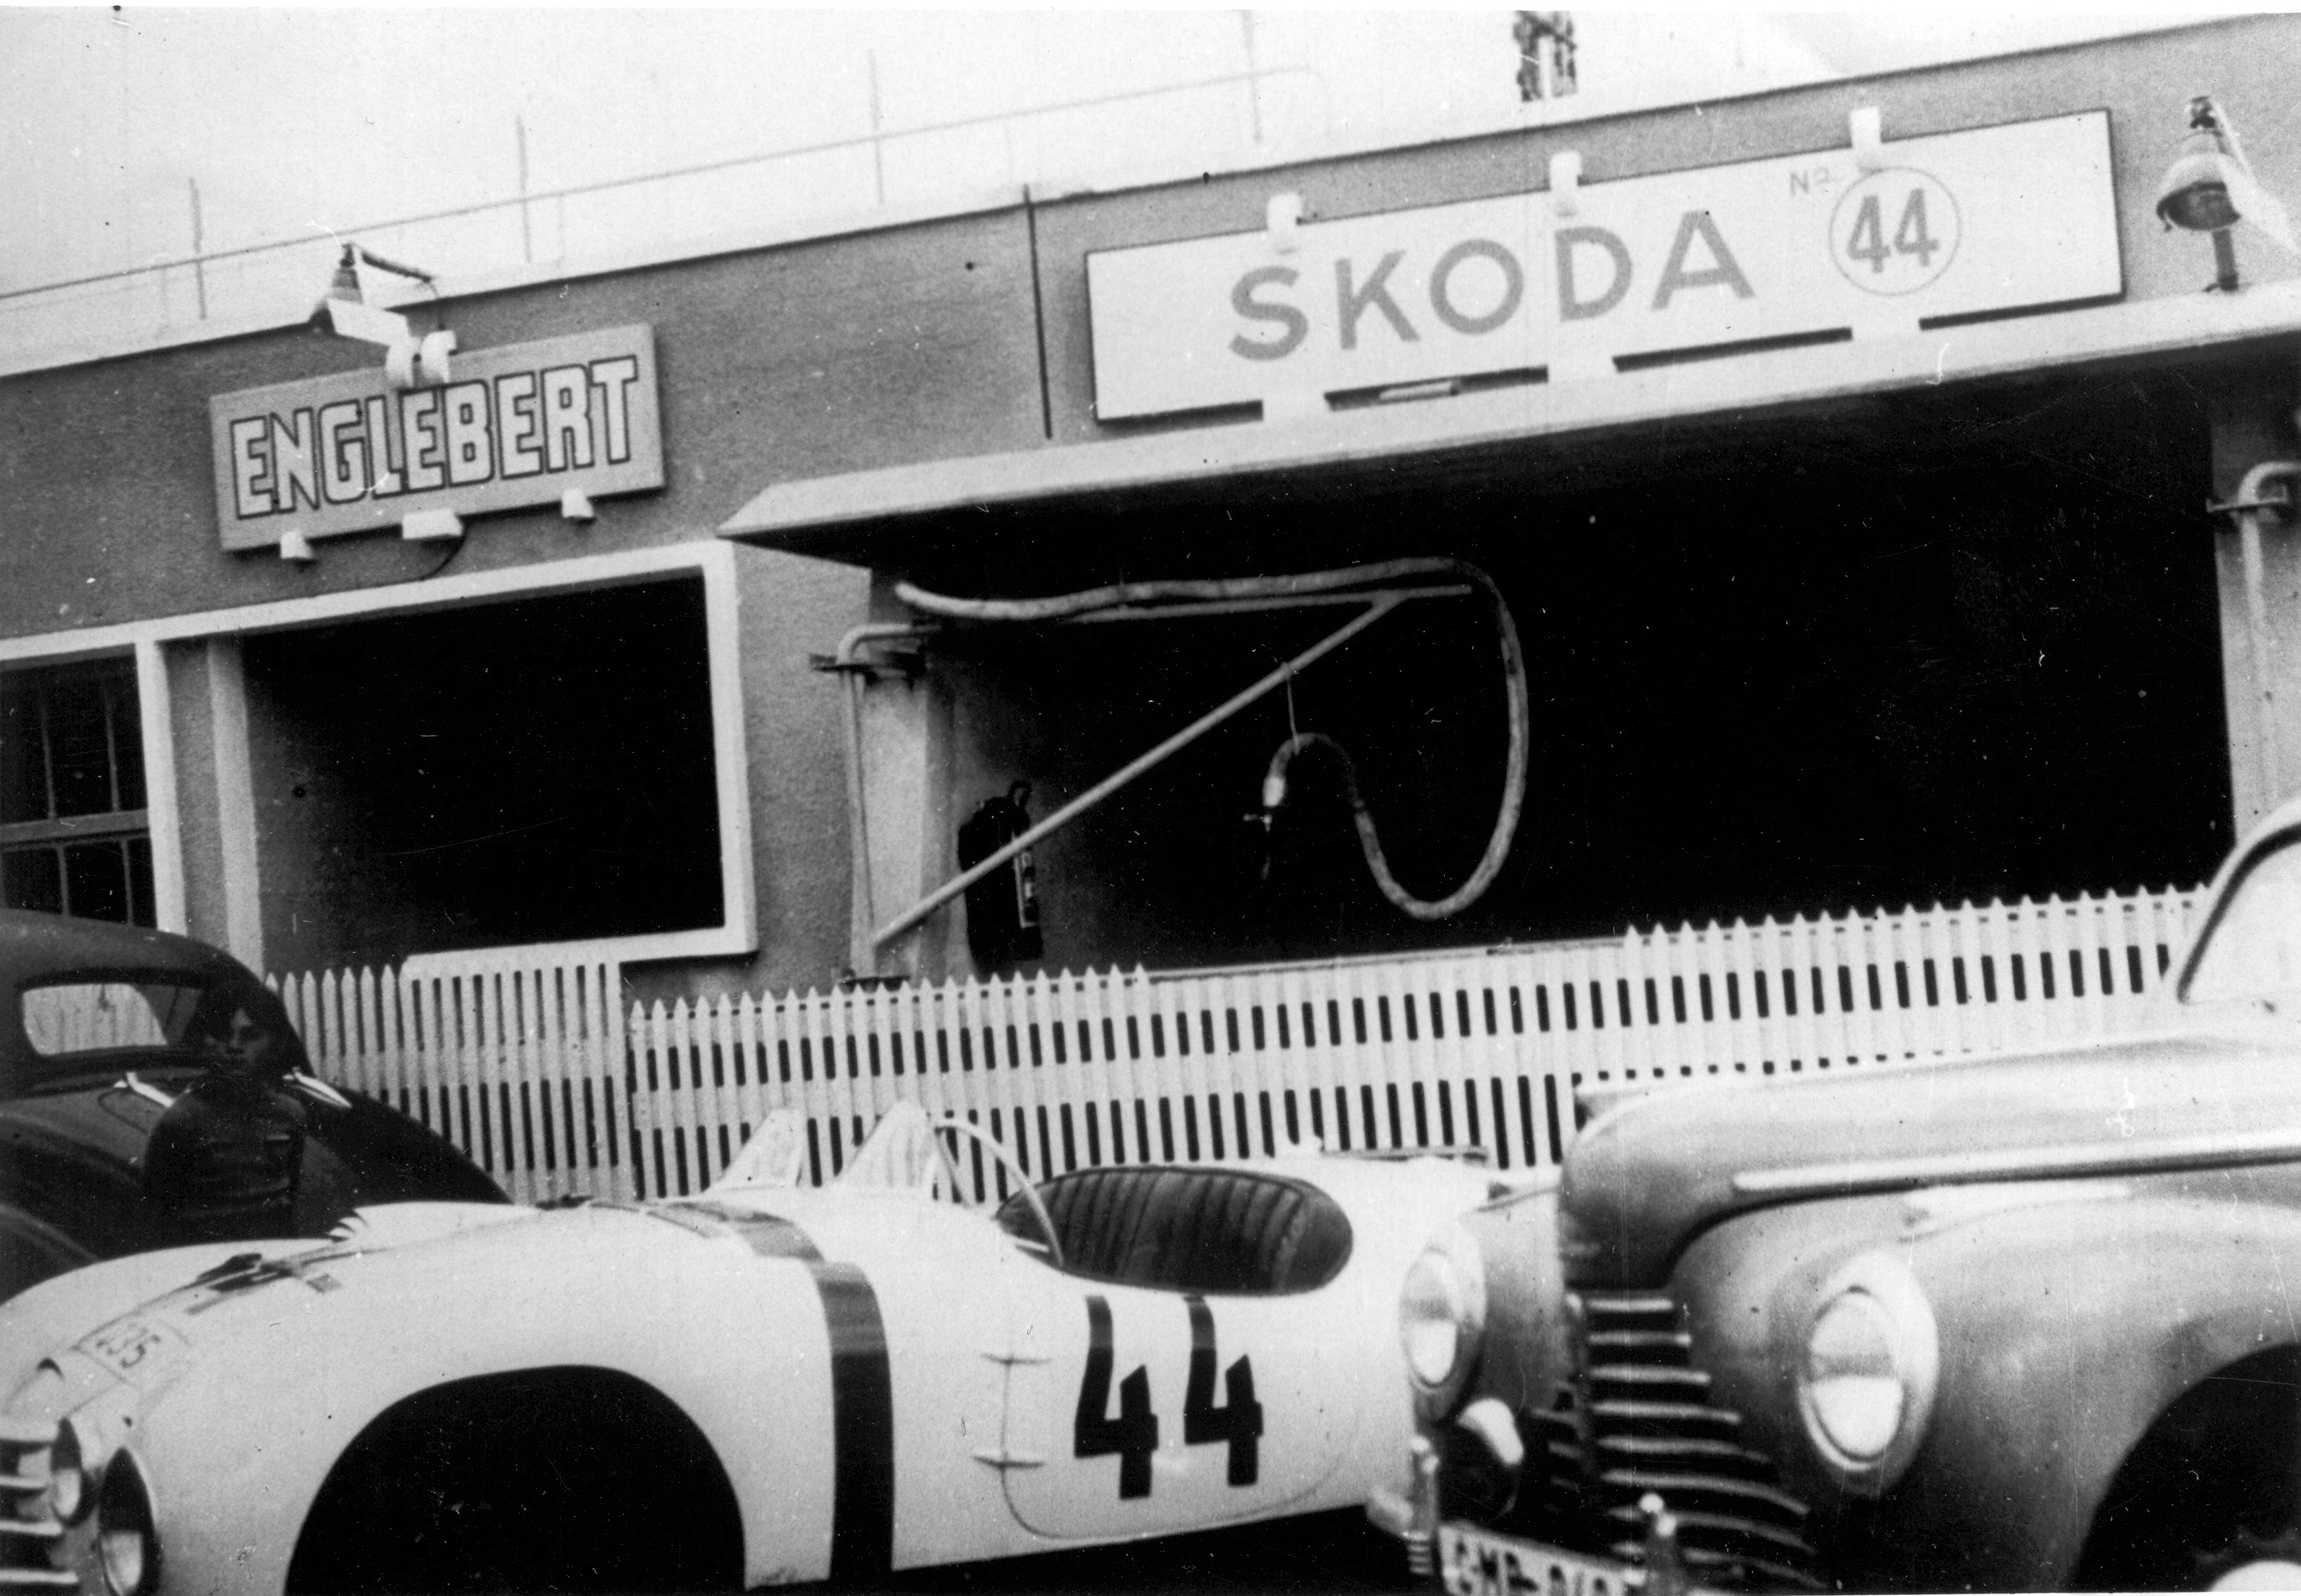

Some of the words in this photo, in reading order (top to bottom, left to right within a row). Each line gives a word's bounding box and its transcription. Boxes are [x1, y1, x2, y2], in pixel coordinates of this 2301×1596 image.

[1228, 209, 1756, 362] SKODA
[1846, 186, 1939, 274] 44
[230, 354, 639, 521] ENGLEBERT
[1073, 1294, 1265, 1502] 44
